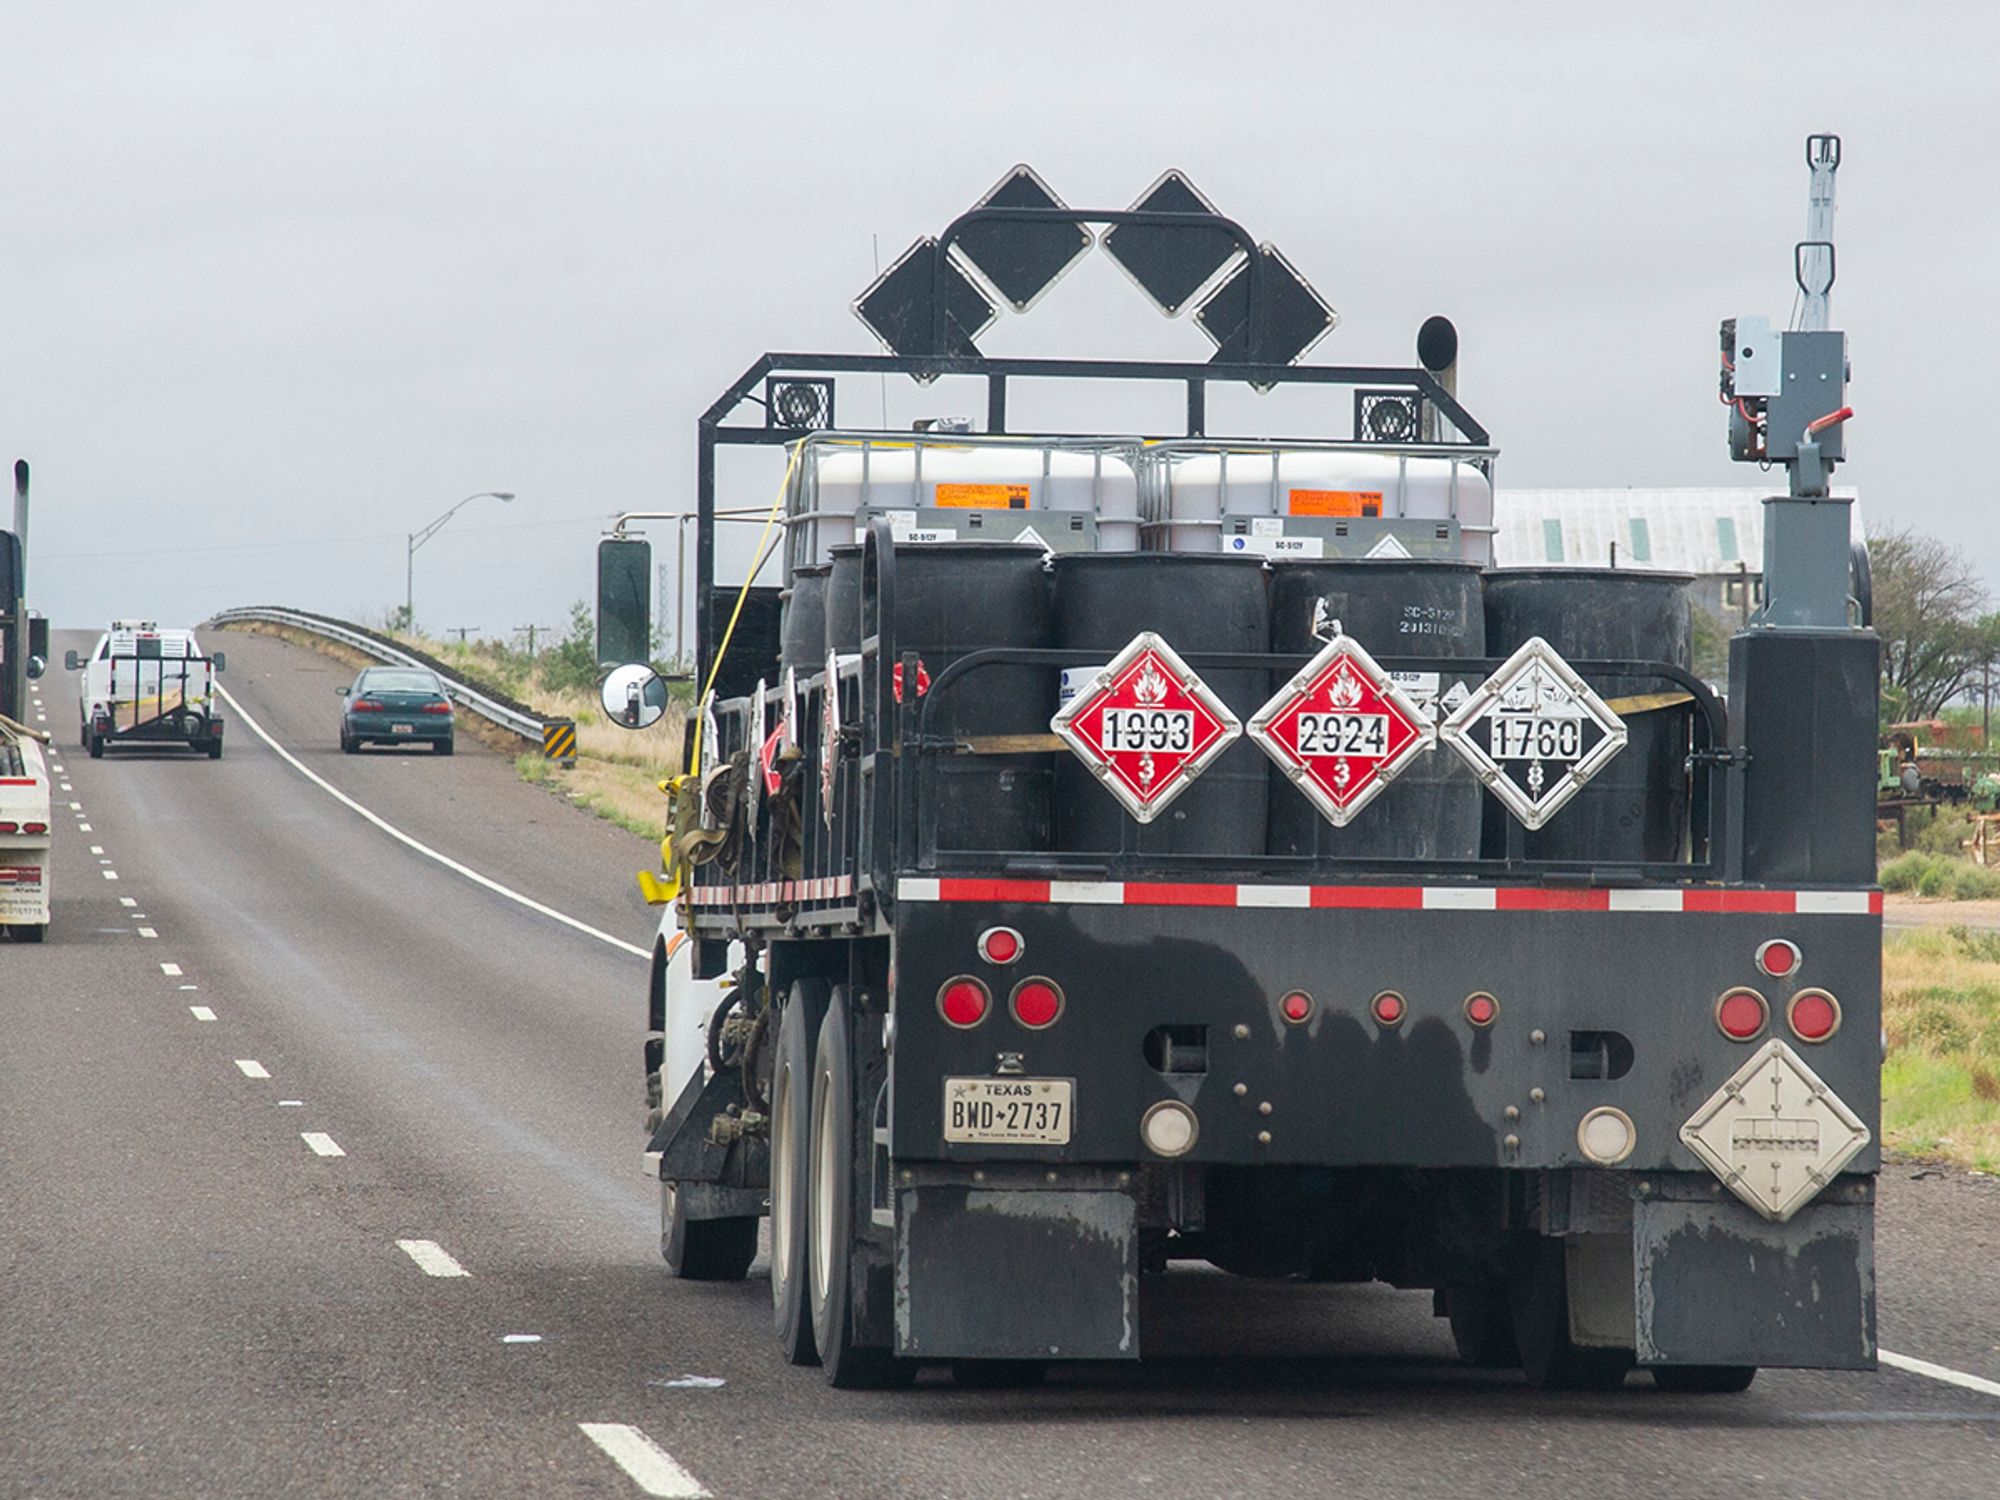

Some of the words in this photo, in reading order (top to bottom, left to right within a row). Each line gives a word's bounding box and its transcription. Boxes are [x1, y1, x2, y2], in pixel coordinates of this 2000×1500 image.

[1106, 711, 1190, 751] 1993
[1300, 715, 1385, 754] 2924
[1494, 719, 1578, 757] 1760
[1138, 759, 1155, 780] 3
[1333, 763, 1350, 784] 3
[984, 1084, 1032, 1096] TEXAS
